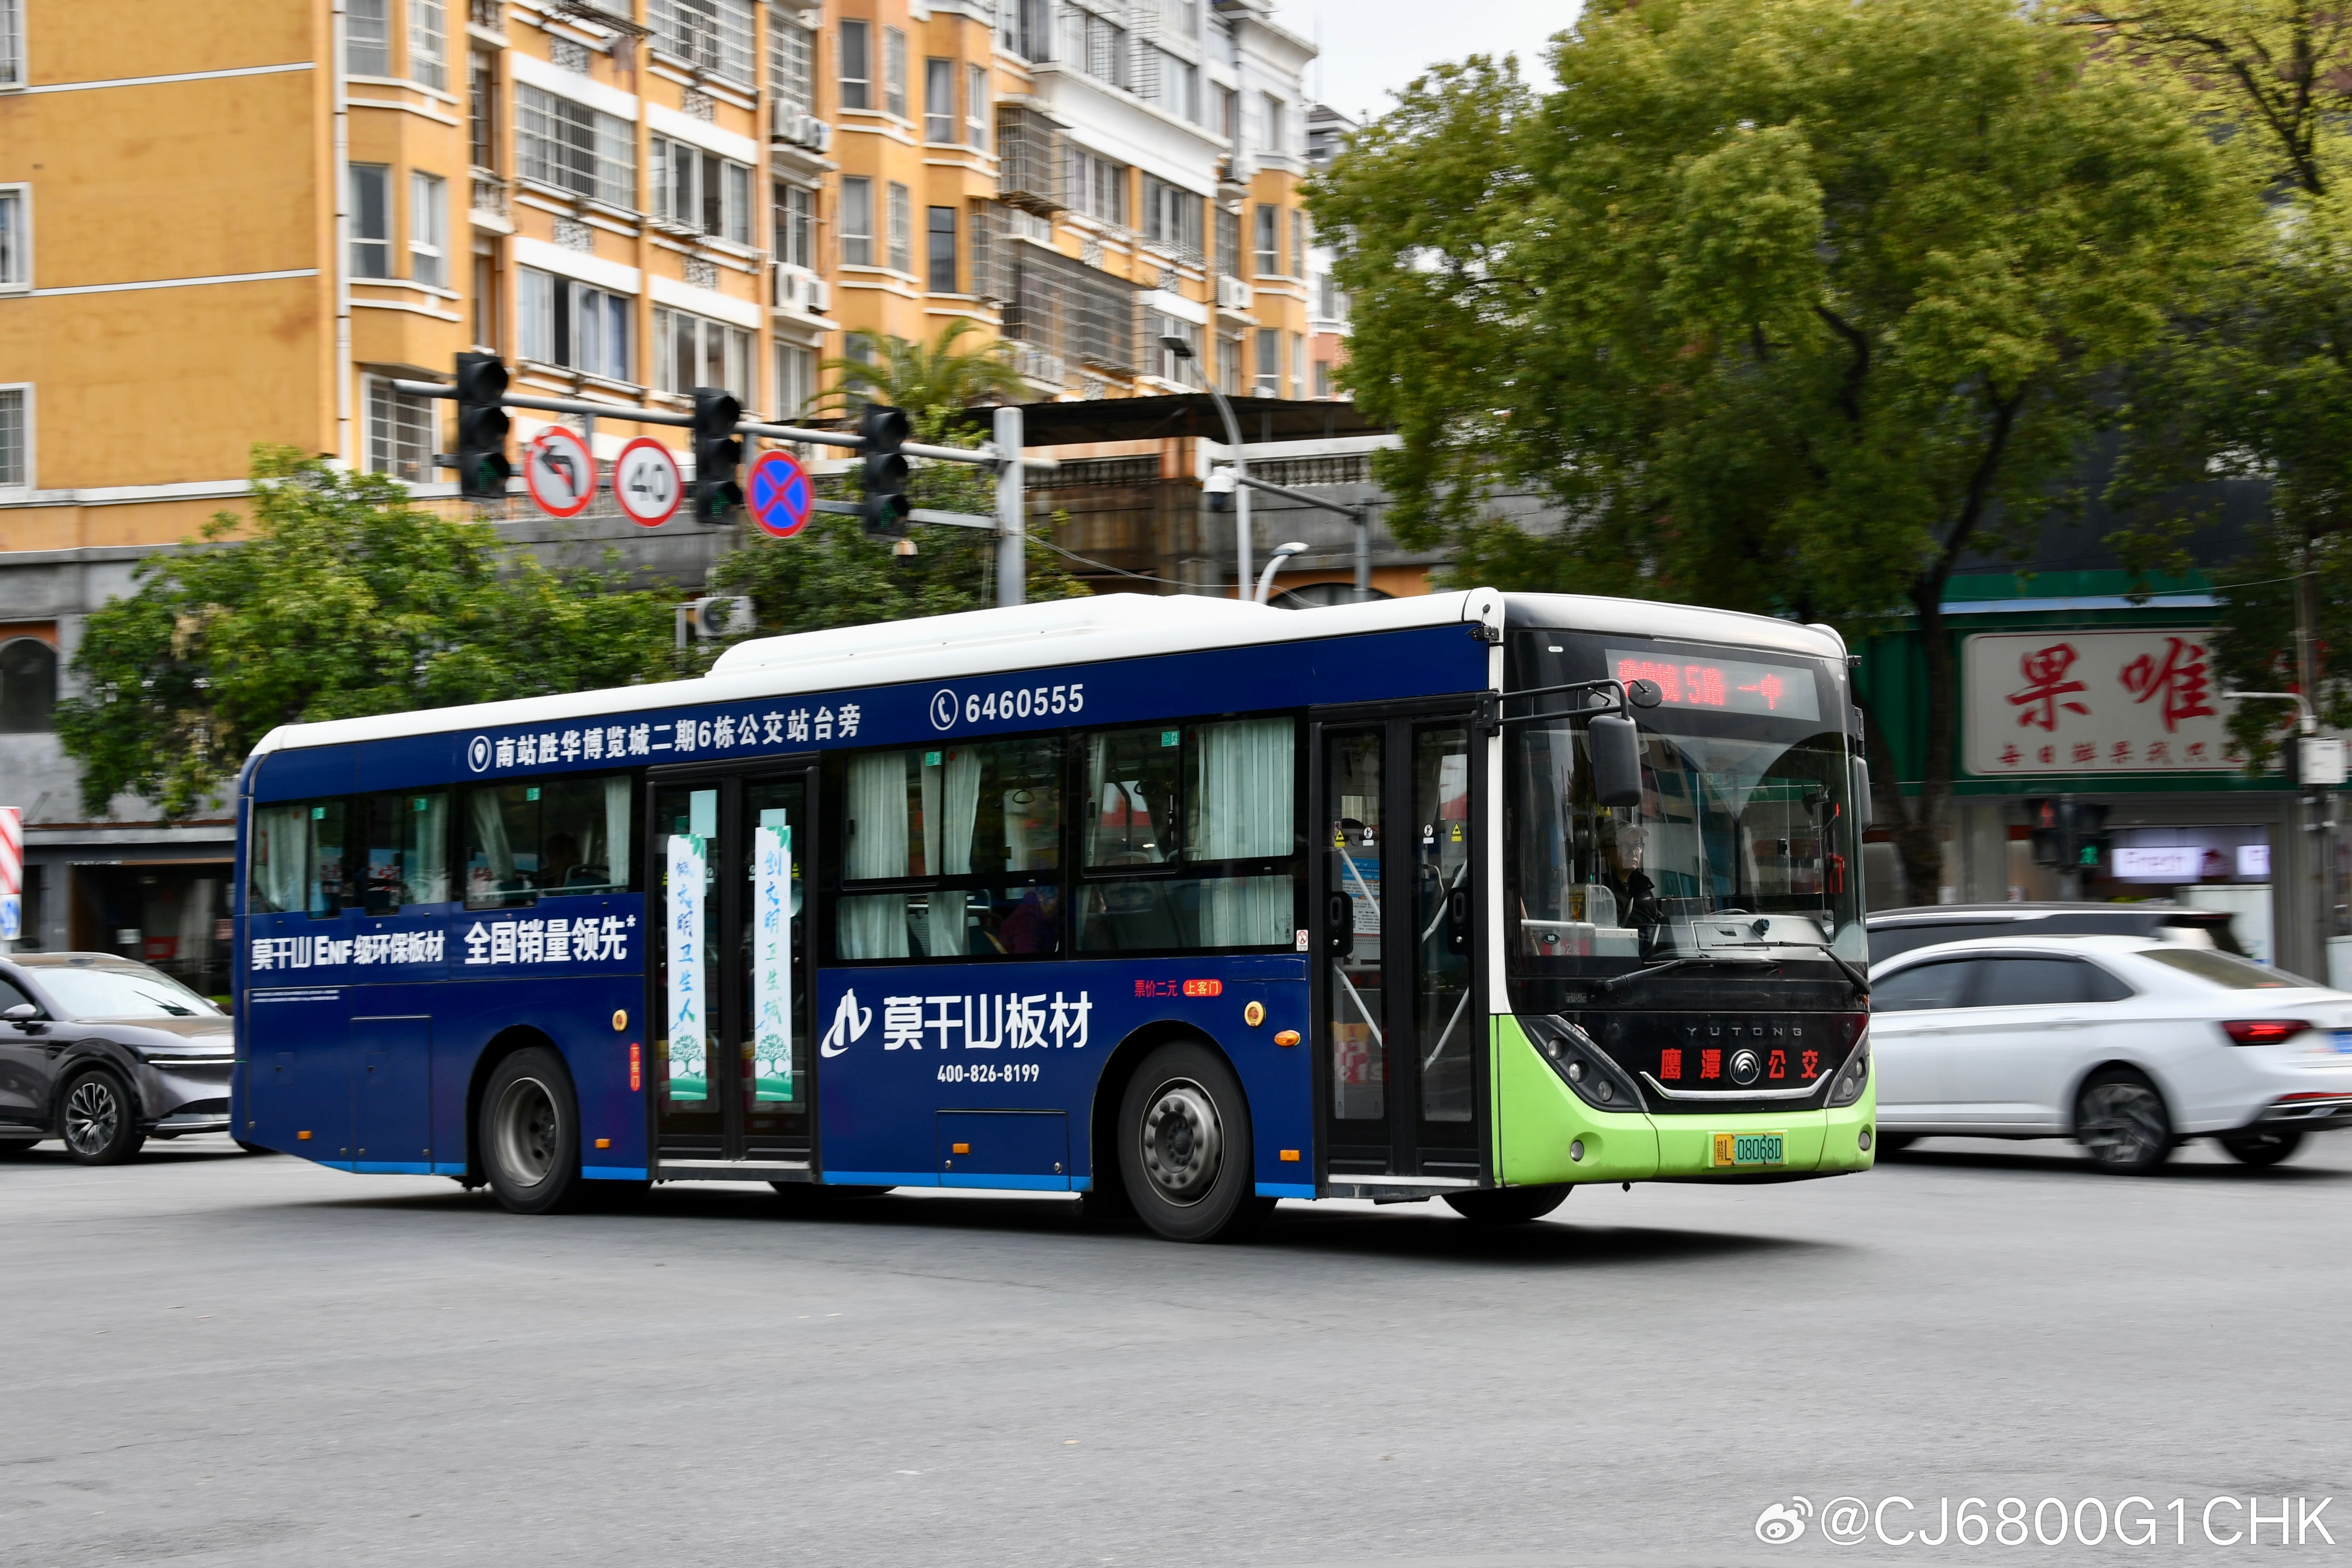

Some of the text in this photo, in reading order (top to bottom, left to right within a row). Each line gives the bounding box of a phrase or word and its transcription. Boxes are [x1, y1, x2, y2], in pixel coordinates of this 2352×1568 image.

[627, 462, 669, 503] 40
[965, 683, 1083, 723] 6460555
[495, 703, 862, 769] 南站胜华博览城二期6栋公交站台旁
[1134, 980, 1220, 998] 票价二元 上客门
[883, 991, 1093, 1051] 莫干山板材
[1687, 1027, 1803, 1037] YUTONG
[937, 1064, 1039, 1083] 400-826-8199
